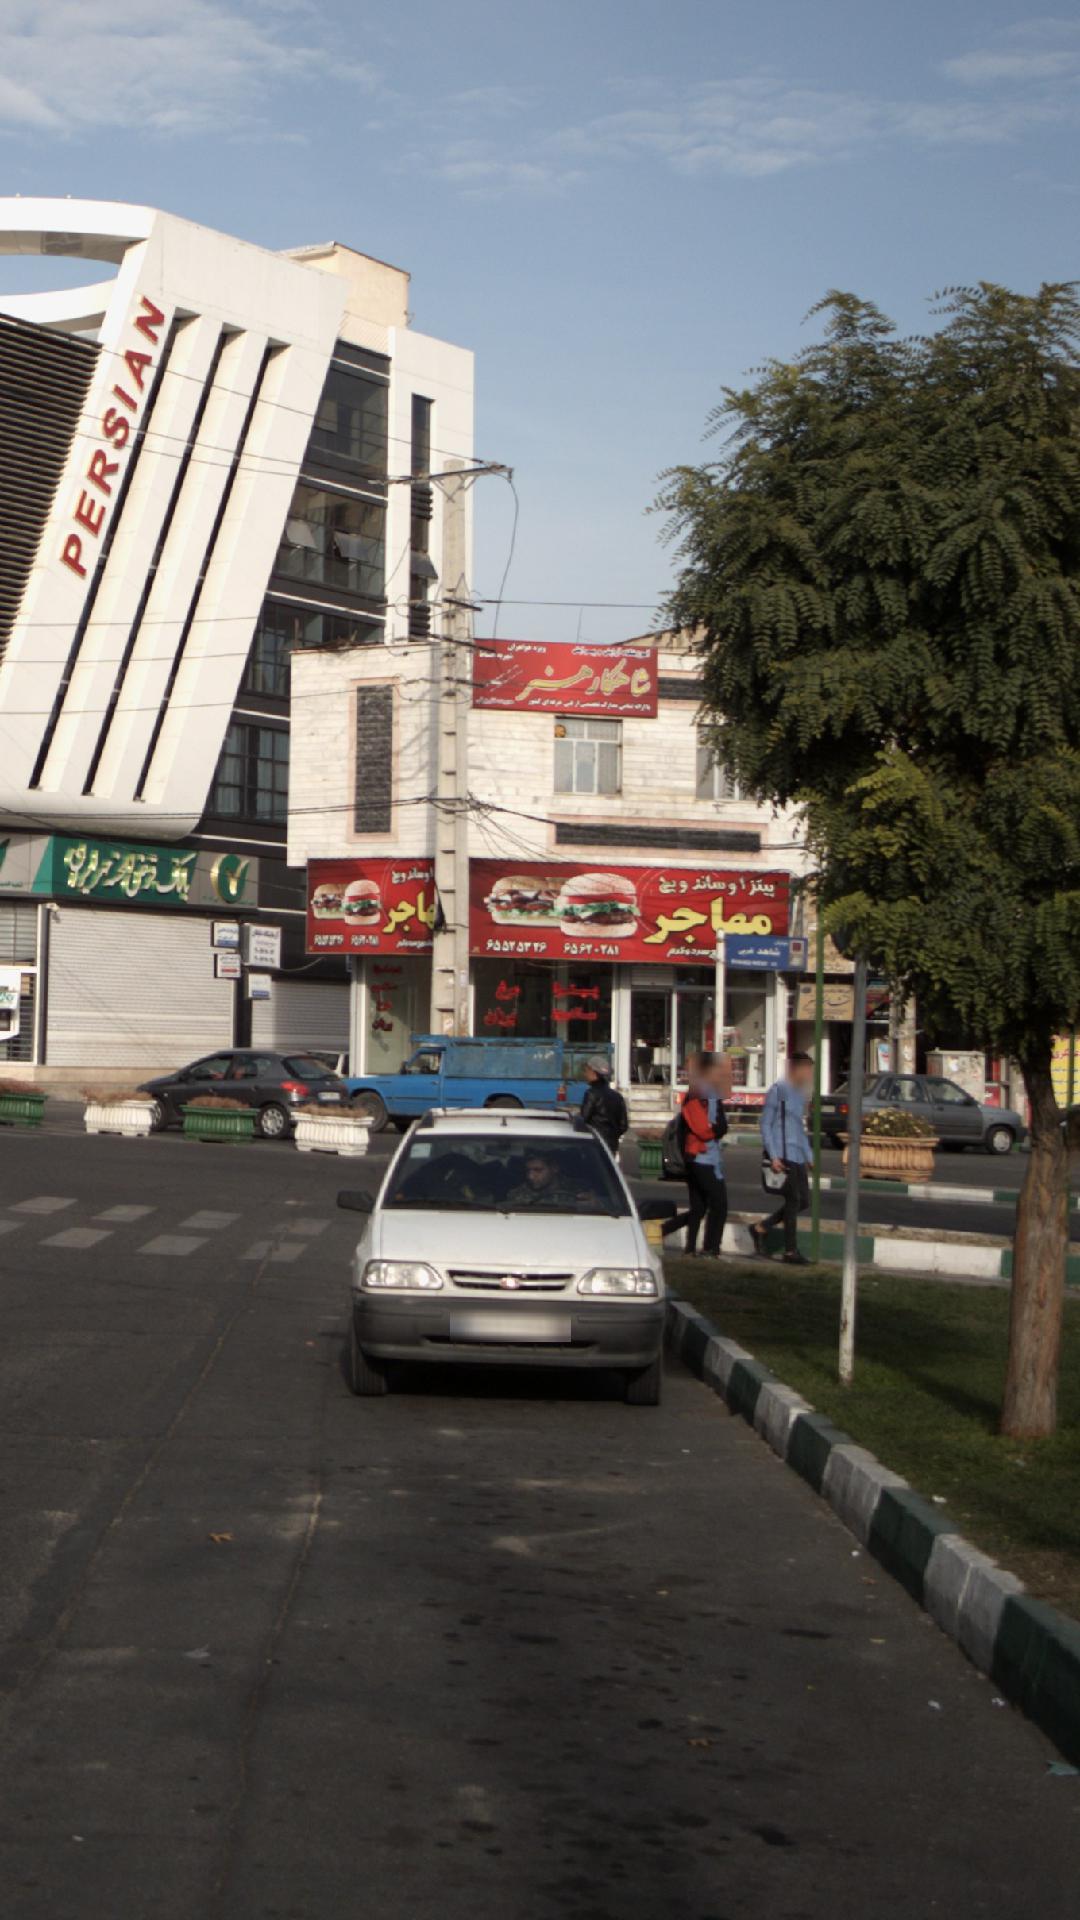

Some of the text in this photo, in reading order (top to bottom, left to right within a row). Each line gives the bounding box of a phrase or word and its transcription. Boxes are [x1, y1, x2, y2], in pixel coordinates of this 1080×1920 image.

[59, 295, 165, 579] PERSIAN
[658, 874, 775, 897] پیتزا و ساندویچ
[642, 896, 772, 944] مهاجر
